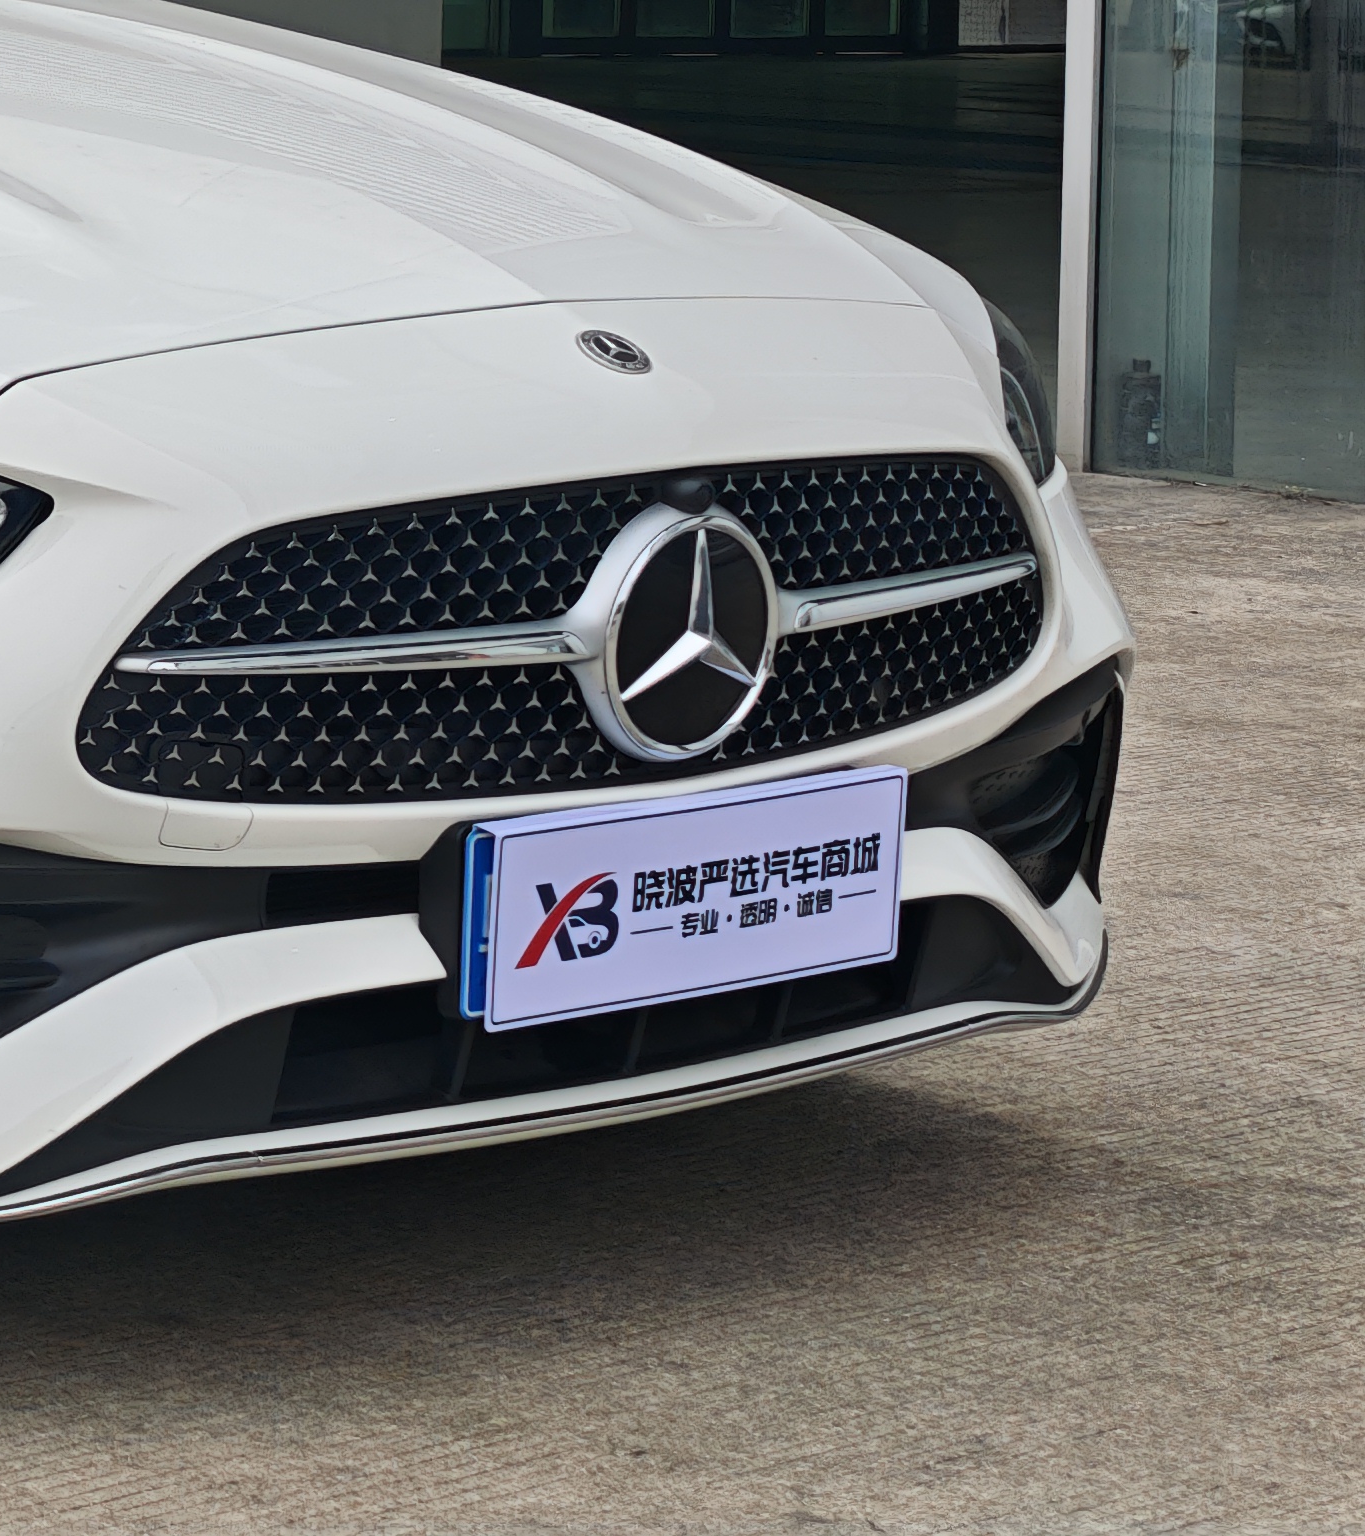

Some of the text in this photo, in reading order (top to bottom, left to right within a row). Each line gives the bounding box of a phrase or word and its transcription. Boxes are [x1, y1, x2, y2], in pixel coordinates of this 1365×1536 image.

[632, 832, 881, 913] 晓波严选汽车商城
